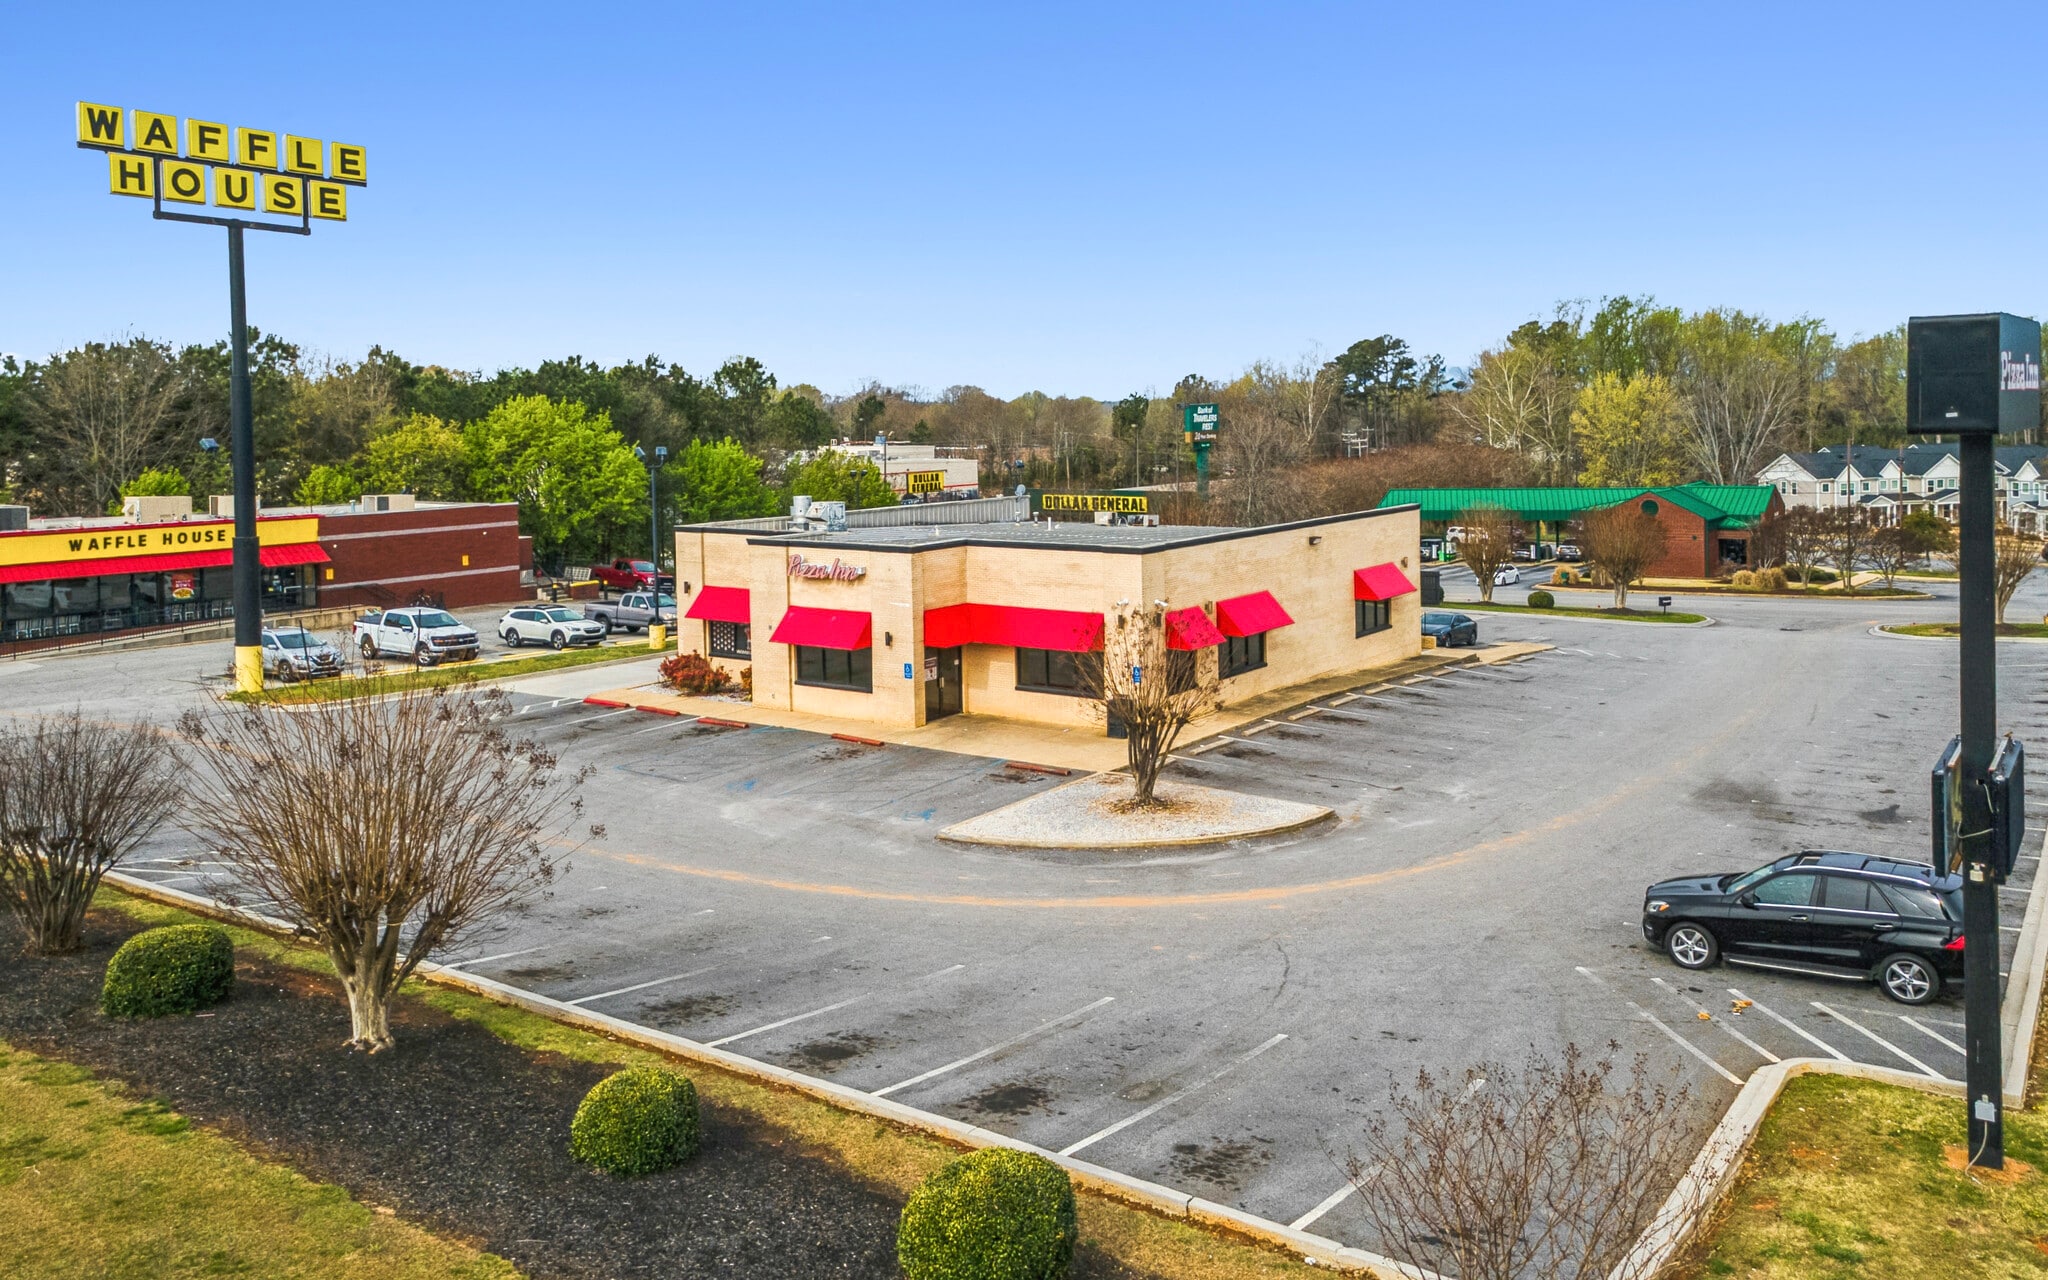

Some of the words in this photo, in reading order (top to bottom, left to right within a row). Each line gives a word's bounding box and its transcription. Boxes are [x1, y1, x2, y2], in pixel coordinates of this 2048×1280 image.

[86, 107, 361, 176] WAFFLE
[119, 159, 341, 215] HOUSE
[2000, 351, 2025, 390] Pizza
[2025, 354, 2039, 389] Inn
[912, 482, 942, 493] GENERAL
[913, 472, 939, 483] DOLLAR
[1044, 495, 1088, 510] DOLLAR
[1092, 496, 1146, 512] GENERAL
[68, 534, 147, 552] WAFFLE
[162, 530, 226, 545] HOUSE
[787, 553, 829, 579] Pizza
[828, 557, 862, 581] Inn
